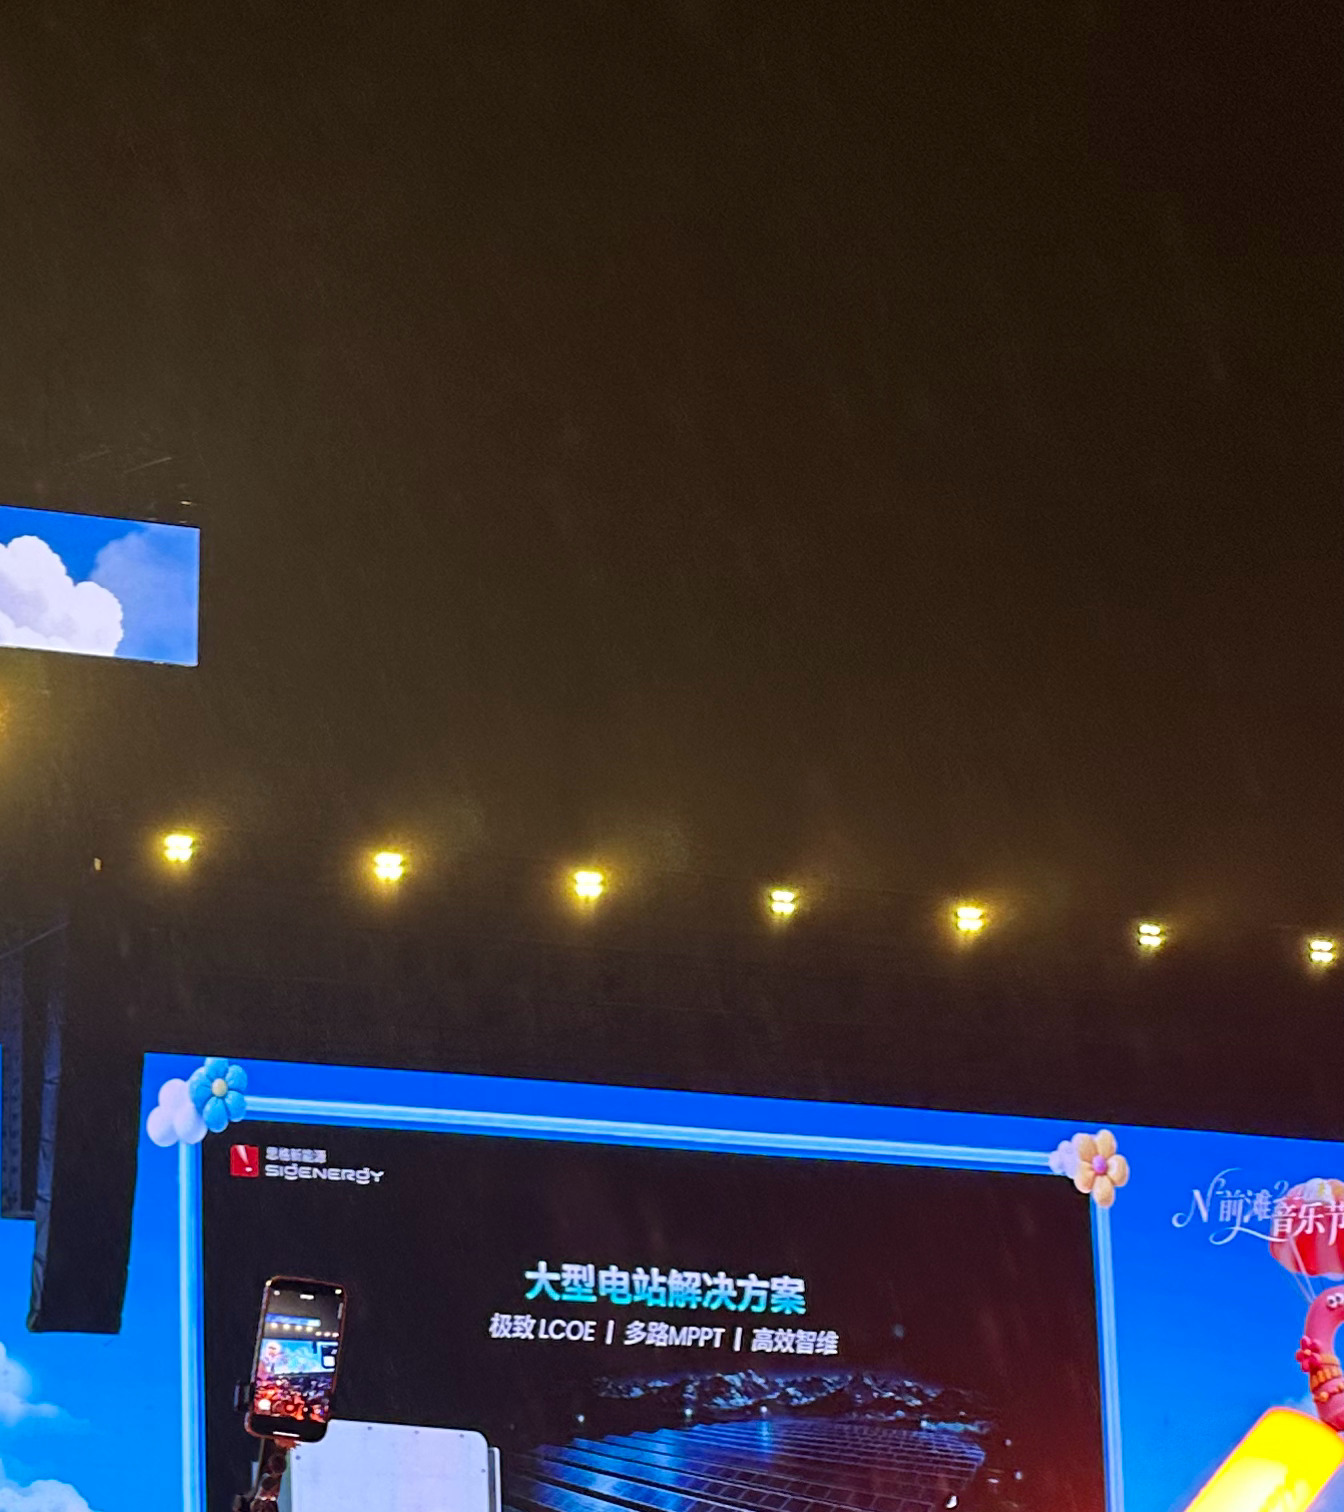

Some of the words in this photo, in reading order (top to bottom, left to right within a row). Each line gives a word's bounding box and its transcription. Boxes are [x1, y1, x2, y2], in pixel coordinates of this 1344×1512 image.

[524, 1260, 807, 1315] 大型电站解决方案
[538, 1318, 597, 1342] LCOE
[751, 1327, 839, 1356] 高效智维
